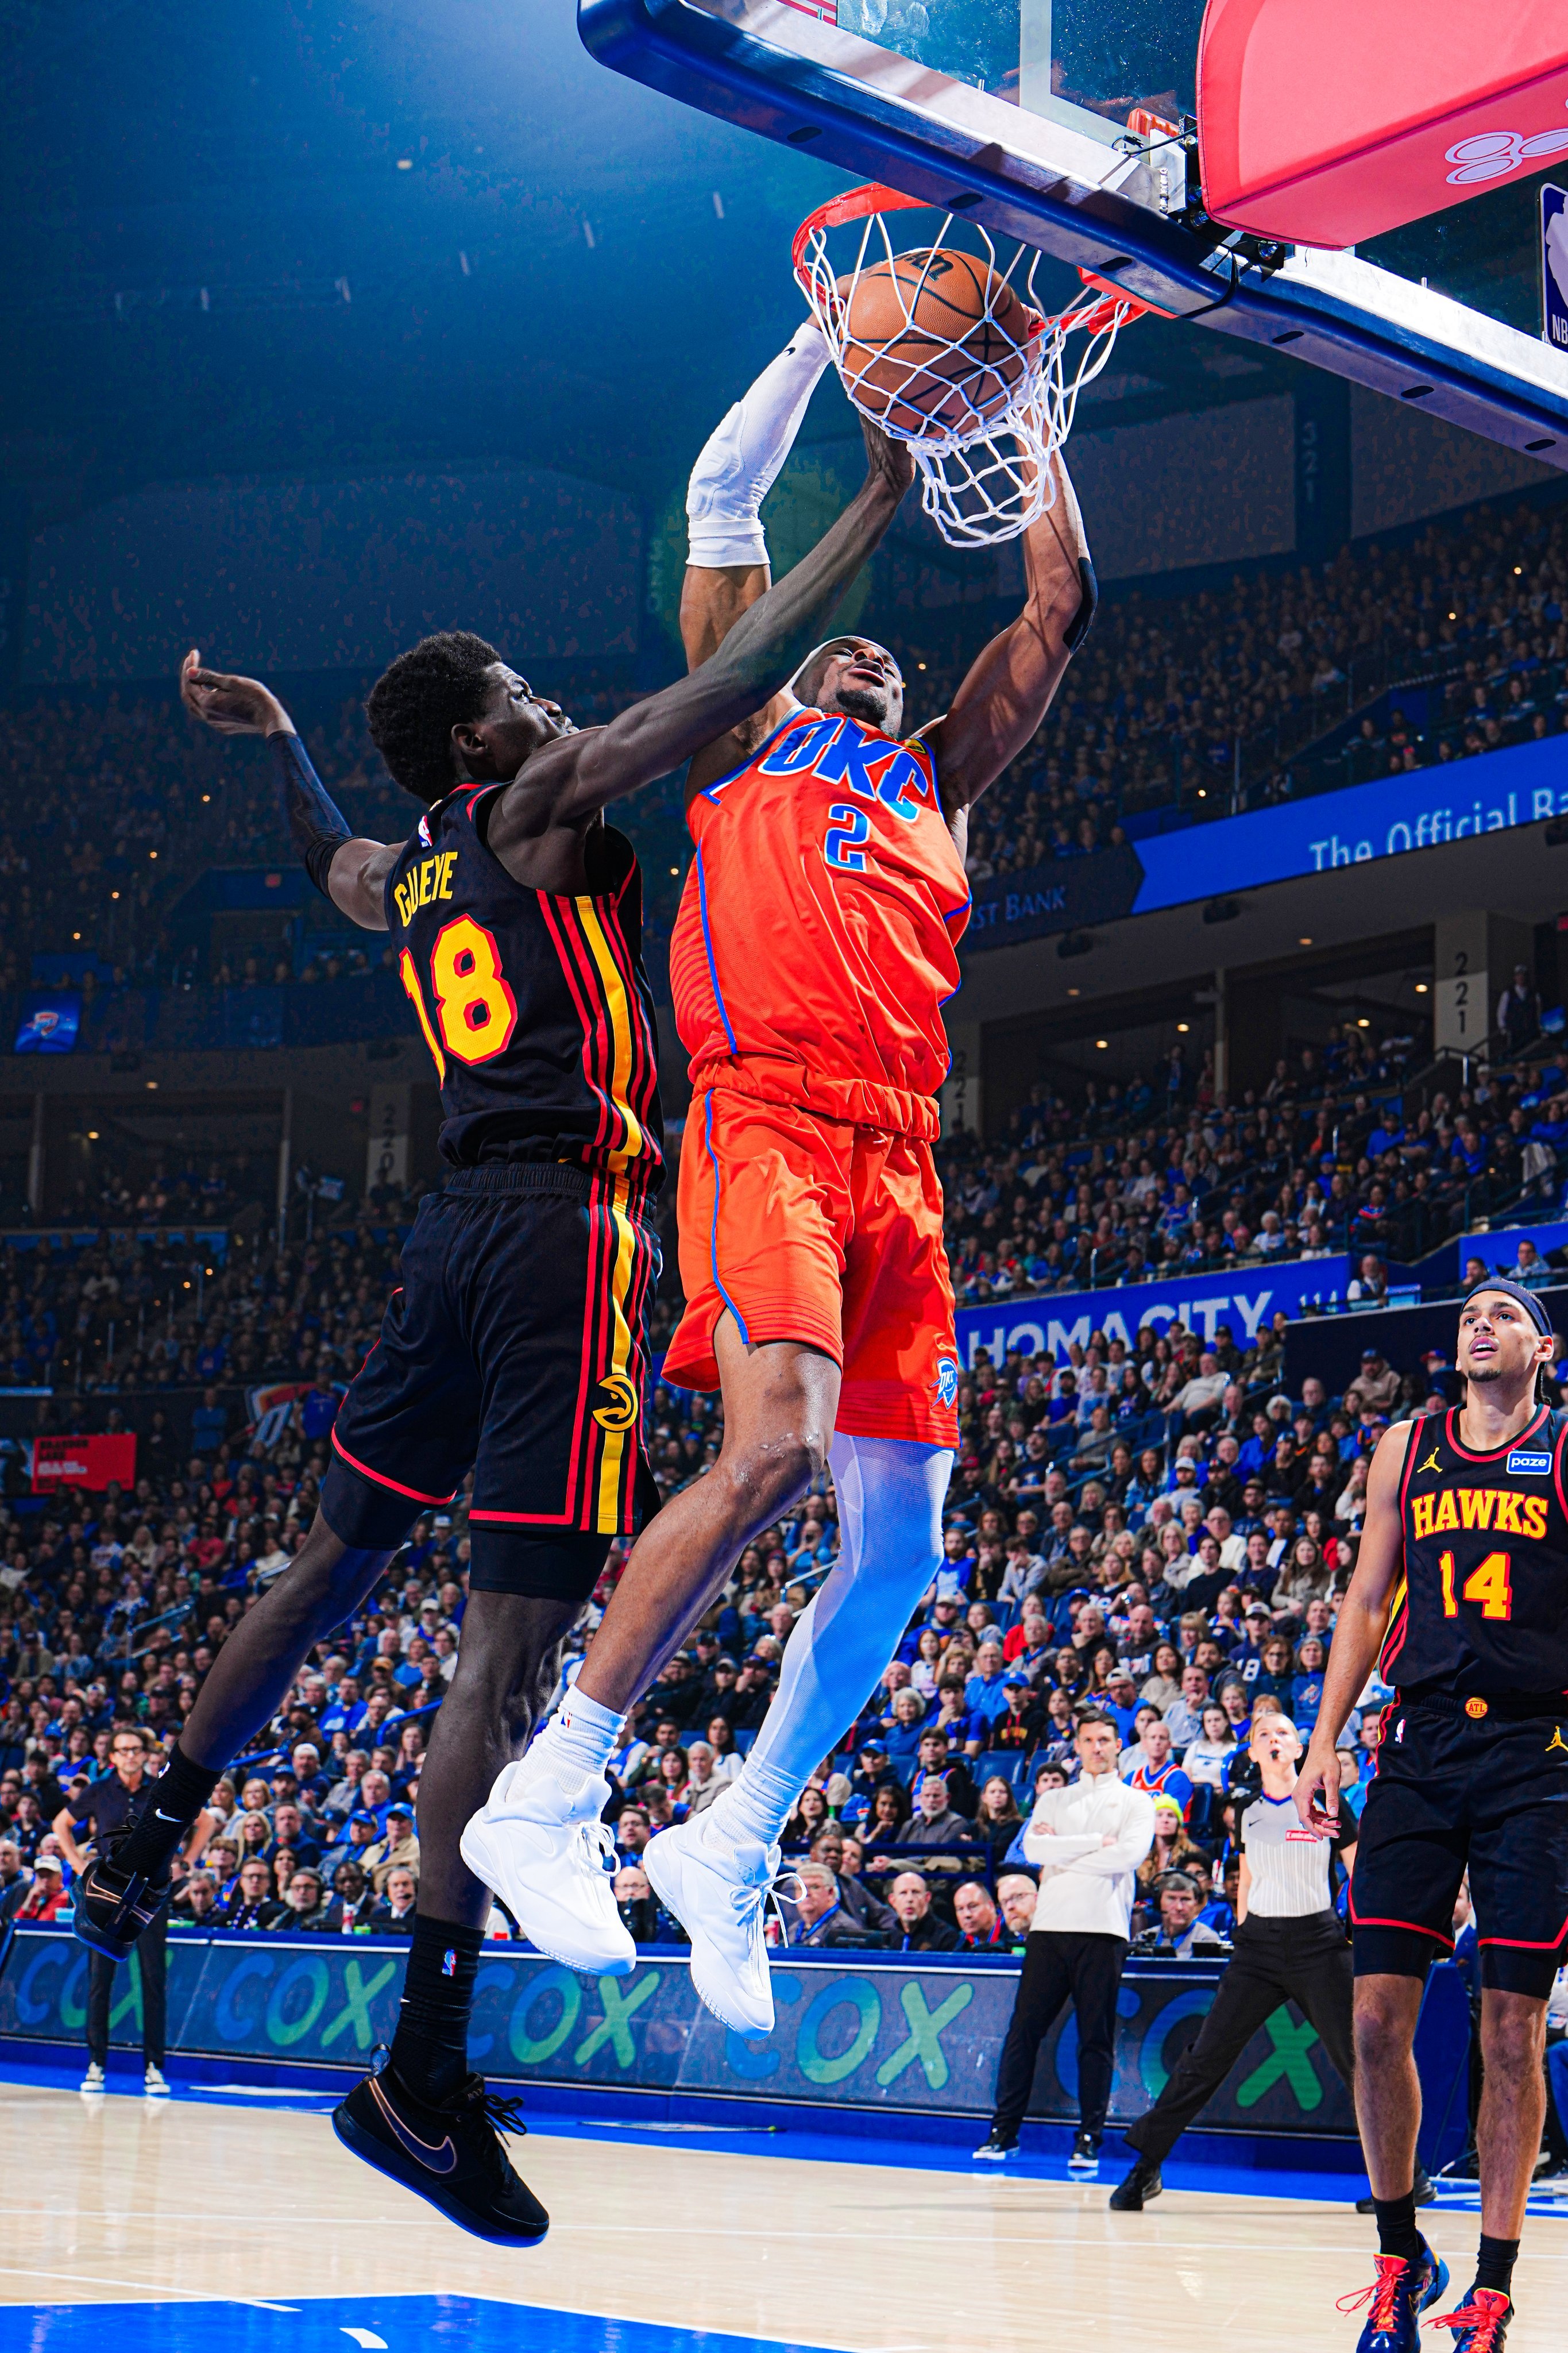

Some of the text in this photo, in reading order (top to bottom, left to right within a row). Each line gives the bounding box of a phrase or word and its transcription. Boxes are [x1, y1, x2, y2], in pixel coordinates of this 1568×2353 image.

[758, 717, 929, 823] OKC
[824, 803, 870, 873] 2
[1310, 835, 1372, 870] The
[1387, 792, 1517, 854] Official
[395, 852, 458, 927] GUEYE
[1006, 886, 1066, 921] BANK
[399, 913, 518, 1091] 18
[1455, 951, 1469, 1034] 221
[957, 1311, 1134, 1372] HOMA
[939, 1371, 954, 1394] OKC
[1511, 1456, 1547, 1468] paze
[1411, 1488, 1548, 1541] HAWKS
[1439, 1550, 1512, 1621] 14
[1469, 1703, 1485, 1712] ATL
[217, 1954, 396, 2050] COX
[726, 1974, 974, 2090] COX
